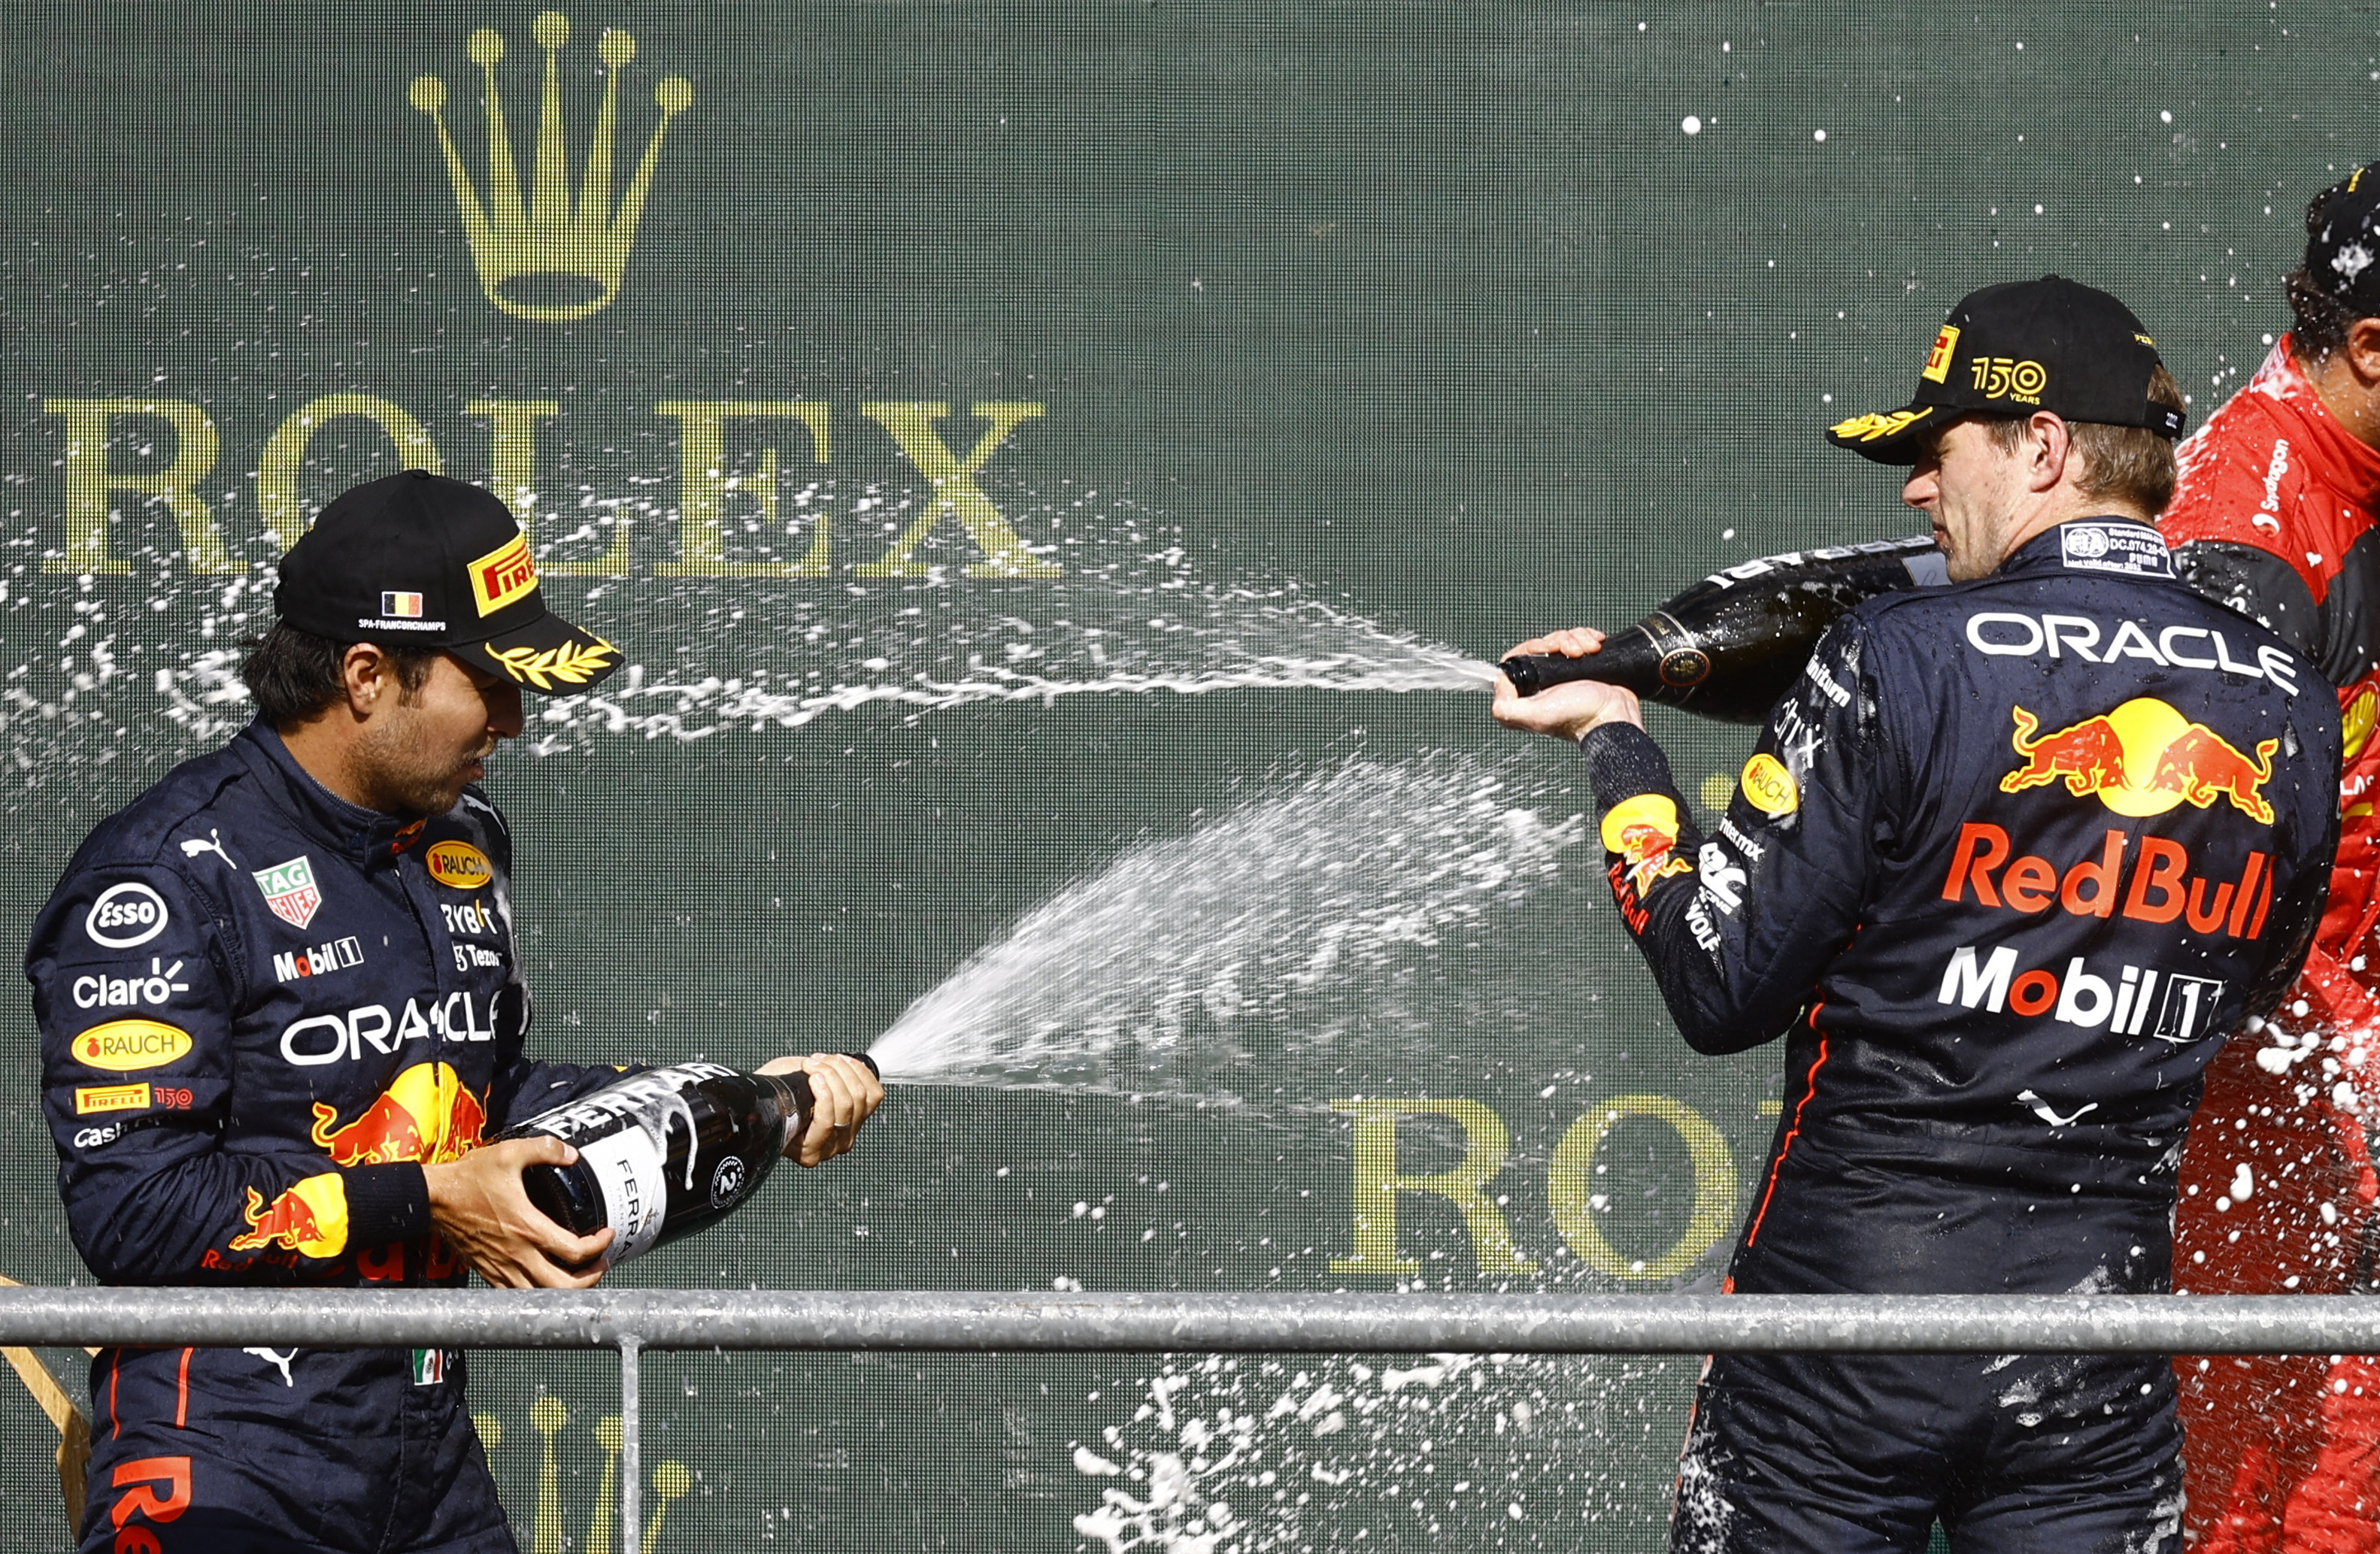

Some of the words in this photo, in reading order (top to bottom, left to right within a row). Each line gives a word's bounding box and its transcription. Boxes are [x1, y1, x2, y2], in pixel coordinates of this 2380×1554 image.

[1971, 356, 2047, 399] 150
[2009, 392, 2041, 406] YEARS
[42, 392, 1062, 579] ROLEX
[358, 618, 446, 632] SPA-FRANCORCHAMPS
[1966, 612, 2300, 696] ORACLE
[1754, 765, 1791, 807] RAUCH
[256, 864, 307, 895] TAG
[442, 854, 486, 876] RAUCH
[1942, 822, 2127, 919] Red
[2123, 835, 2277, 940] Bull
[267, 888, 317, 925] HEUER
[1621, 893, 1651, 935] Bull
[273, 942, 338, 983] Mobil
[73, 974, 170, 1008] Claro
[1937, 946, 2157, 1036] Mobil
[104, 1034, 174, 1056] RAUCH
[83, 1089, 143, 1108] PIRELLI
[154, 1087, 193, 1110] 150
[533, 1062, 740, 1141] FERRARI
[720, 1171, 736, 1195] 2
[1329, 1095, 1783, 1280] RO
